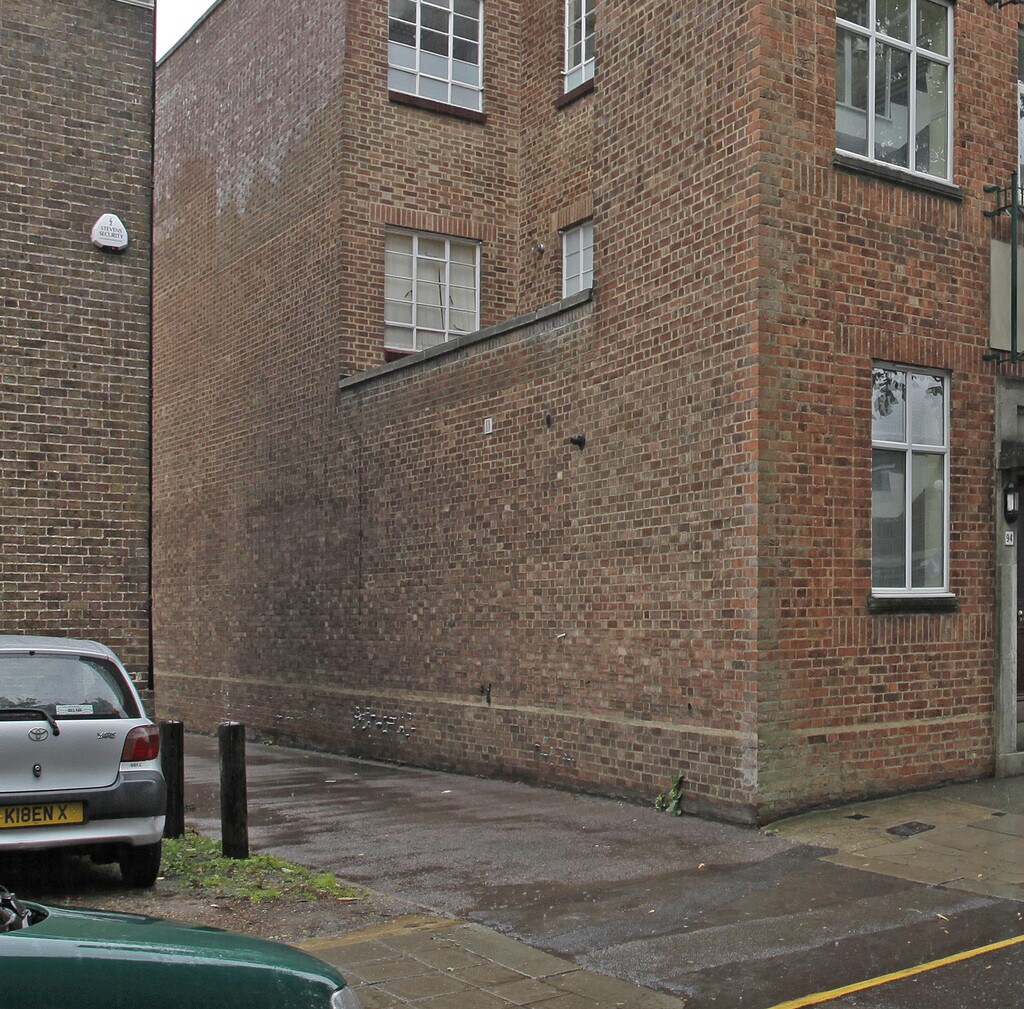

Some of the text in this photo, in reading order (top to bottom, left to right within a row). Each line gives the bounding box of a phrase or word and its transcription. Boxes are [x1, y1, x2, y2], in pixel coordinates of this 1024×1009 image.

[101, 225, 122, 234] STEVENS
[100, 231, 122, 240] SECURITY
[1006, 533, 1013, 543] 94
[58, 804, 67, 820] X
